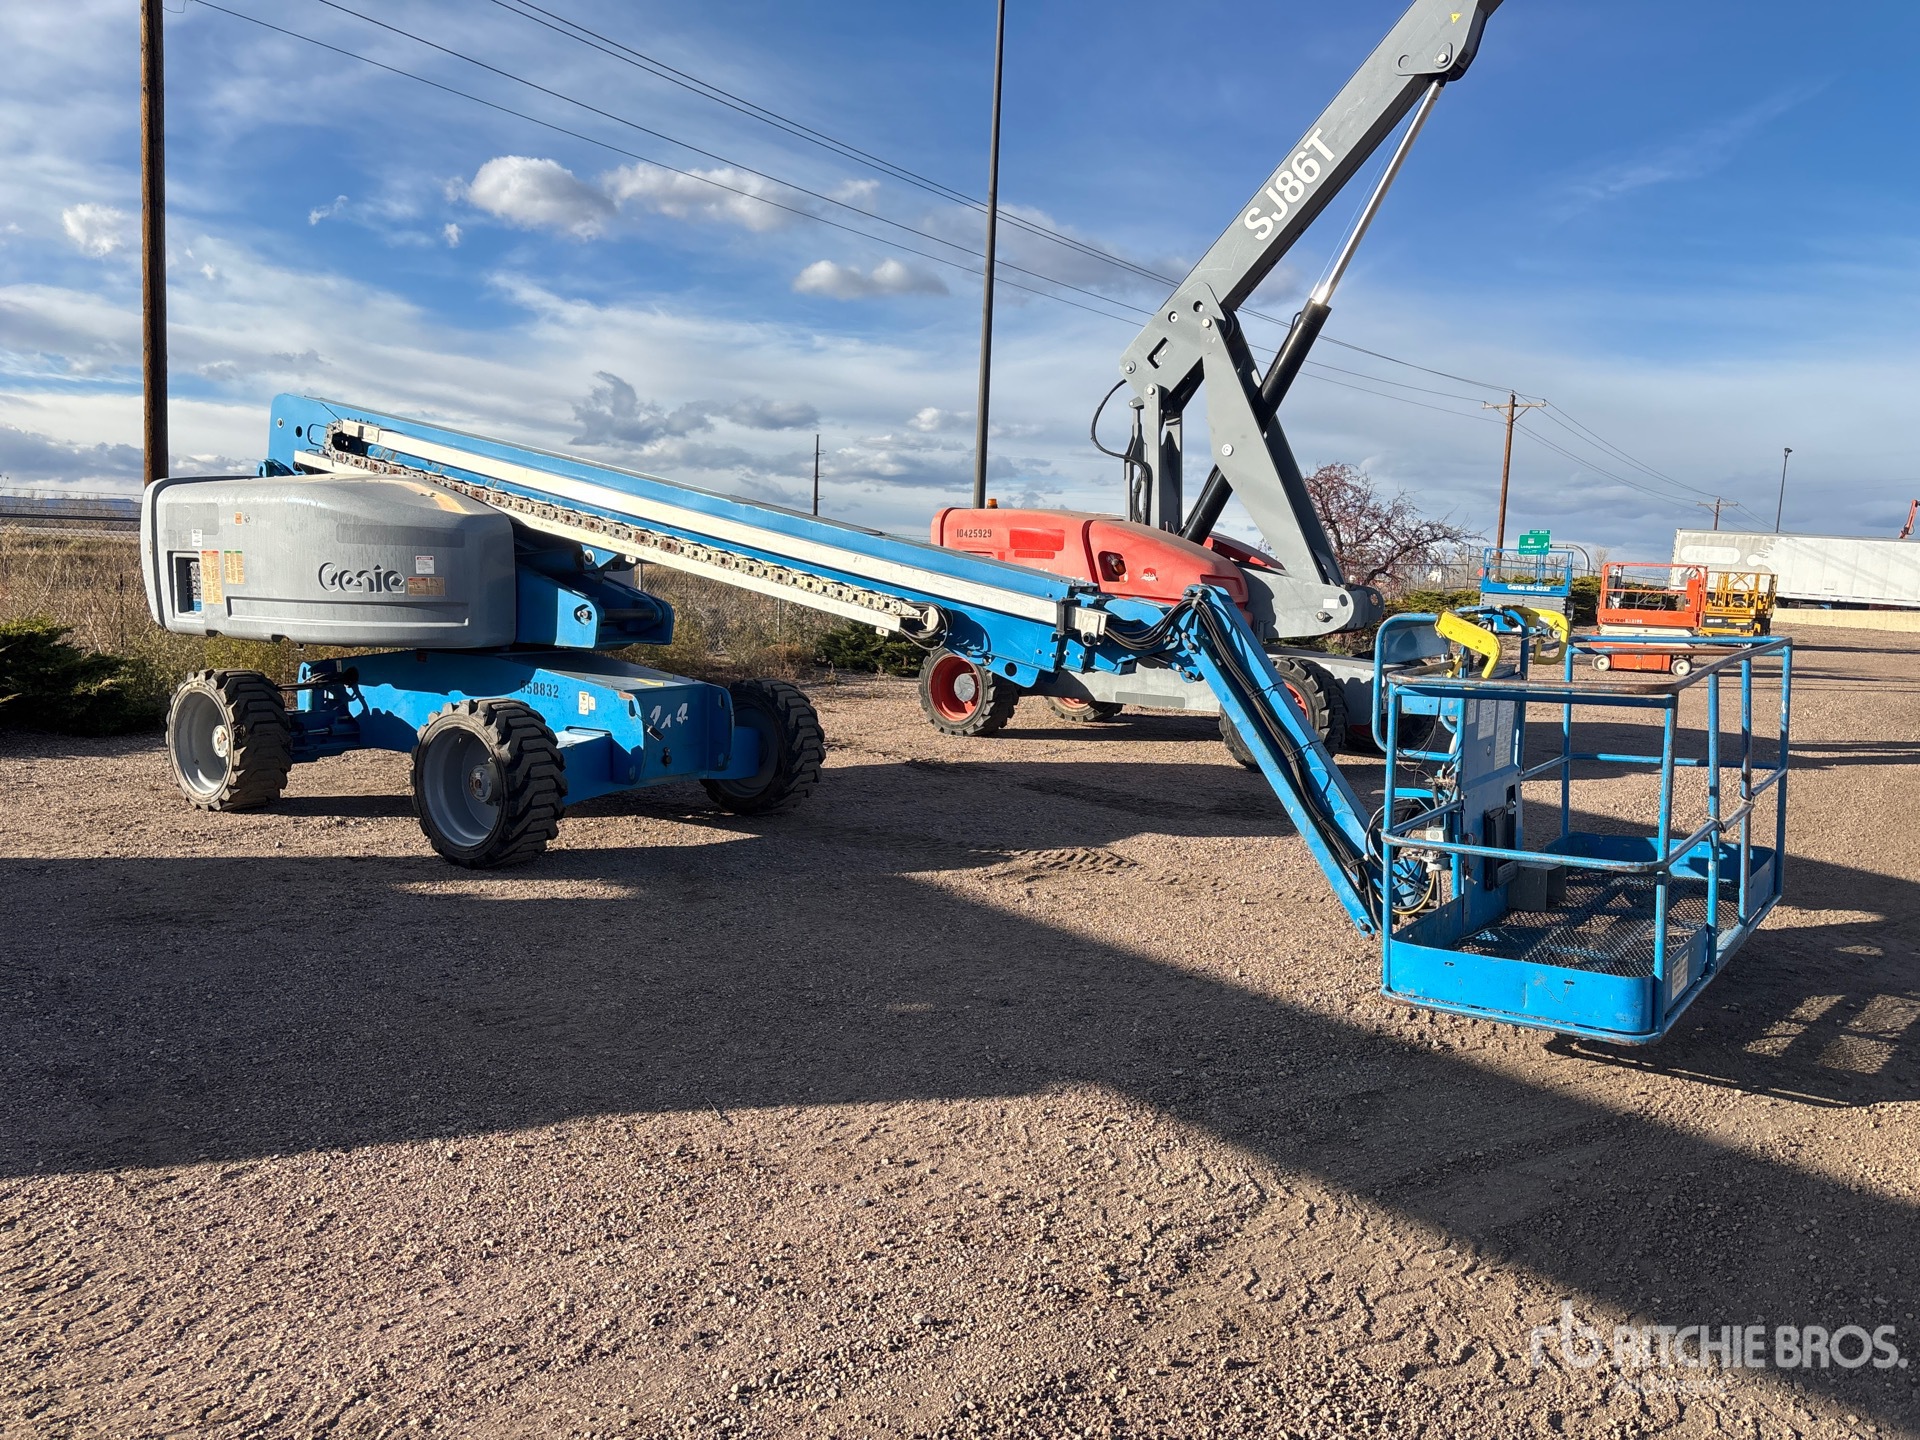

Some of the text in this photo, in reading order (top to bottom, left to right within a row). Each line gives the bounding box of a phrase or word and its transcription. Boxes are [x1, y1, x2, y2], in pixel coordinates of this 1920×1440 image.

[1244, 127, 1335, 241] SJ86T
[956, 528, 992, 538] 10425929
[318, 562, 405, 593] Genie
[1507, 583, 1525, 591] Genie
